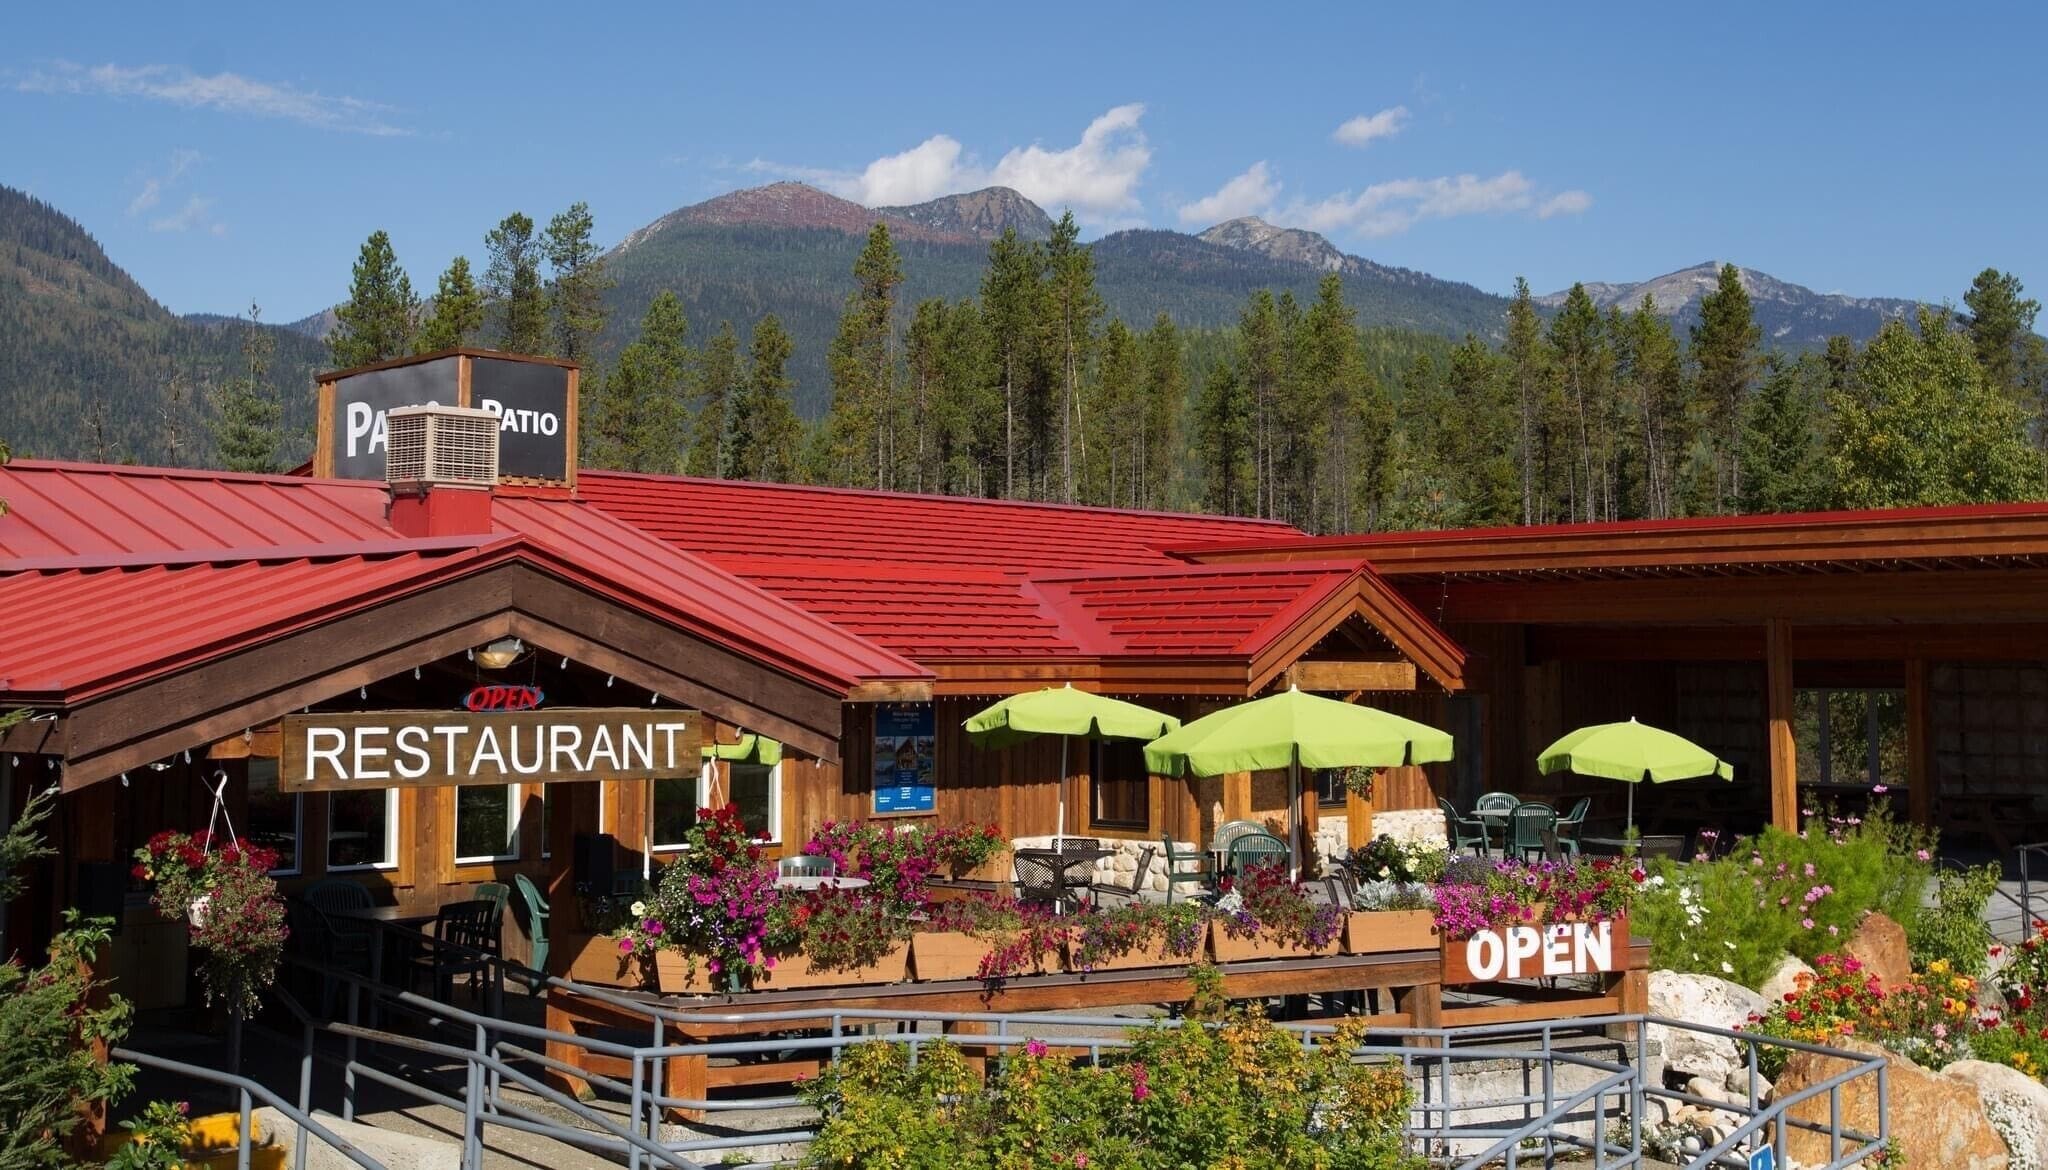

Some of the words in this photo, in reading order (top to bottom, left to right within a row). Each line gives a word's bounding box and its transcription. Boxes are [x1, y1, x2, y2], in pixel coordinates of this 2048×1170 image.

[467, 687, 541, 711] OPEN
[304, 723, 685, 780] RESTAURANT
[1466, 921, 1612, 981] OPEN
